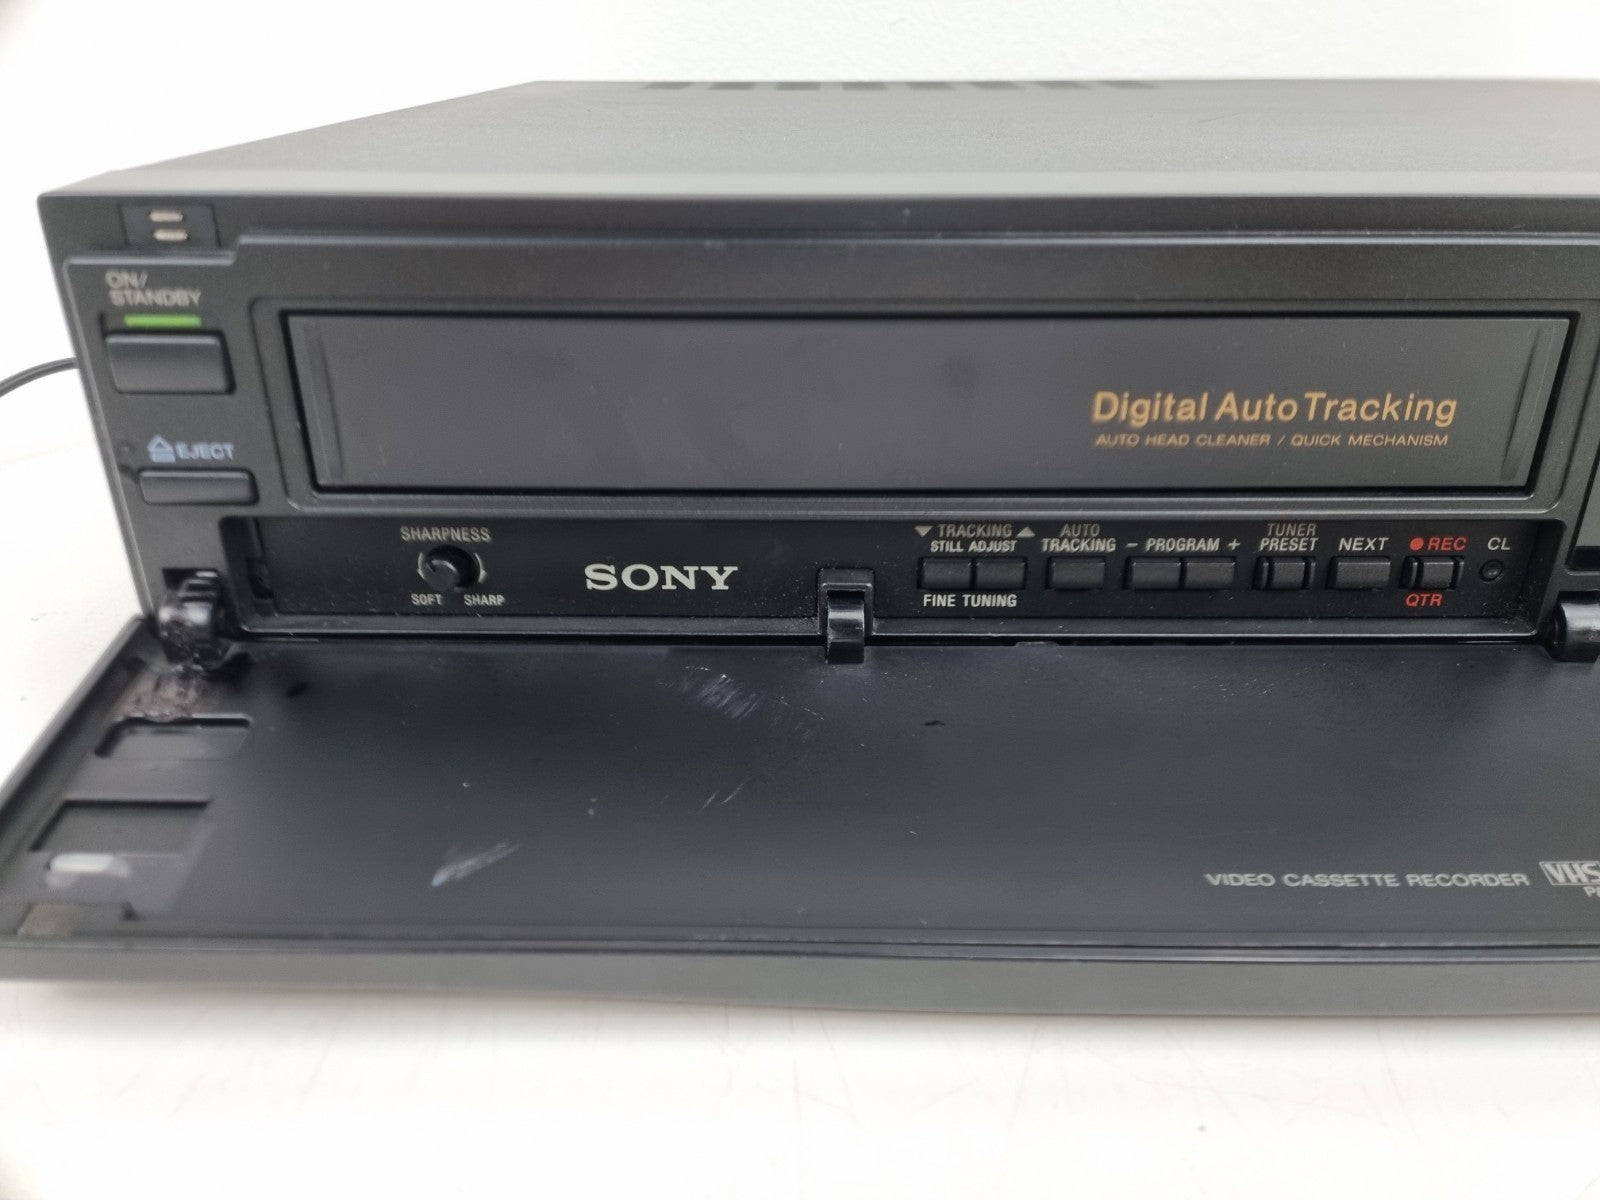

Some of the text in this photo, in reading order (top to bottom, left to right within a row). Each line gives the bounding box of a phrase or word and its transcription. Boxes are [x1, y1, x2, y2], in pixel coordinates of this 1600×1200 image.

[104, 271, 149, 289] ON/
[108, 289, 201, 306] STANDBY
[1091, 391, 1458, 428] Digital Auto Tracking
[1095, 434, 1140, 447] AUTO
[1144, 434, 1190, 447] HEAD
[1195, 434, 1271, 447] CLEANER
[1290, 434, 1341, 447] QUICK
[1348, 434, 1449, 447] MECHANISM
[174, 442, 236, 461] EJECT
[400, 526, 493, 543] SHARPNESS
[937, 523, 1013, 539] TRACKING
[1059, 523, 1101, 538] AUTO
[1267, 523, 1317, 537] TUNER
[930, 540, 1018, 553] STILL ADJUST
[1041, 538, 1117, 553] TRACKING
[1145, 538, 1221, 552] PROGRAM
[1260, 537, 1319, 552] PRESET
[1338, 537, 1390, 551] NEXT
[1427, 537, 1468, 551] REC
[1487, 537, 1511, 551] CL
[584, 563, 739, 592] SONY
[411, 593, 443, 606] SOFT
[463, 594, 506, 607] SHARP
[923, 594, 1018, 608] FINE TUNING
[1405, 593, 1444, 608] QTR
[1205, 872, 1530, 888] VIDEO CASSETTE RECORDER
